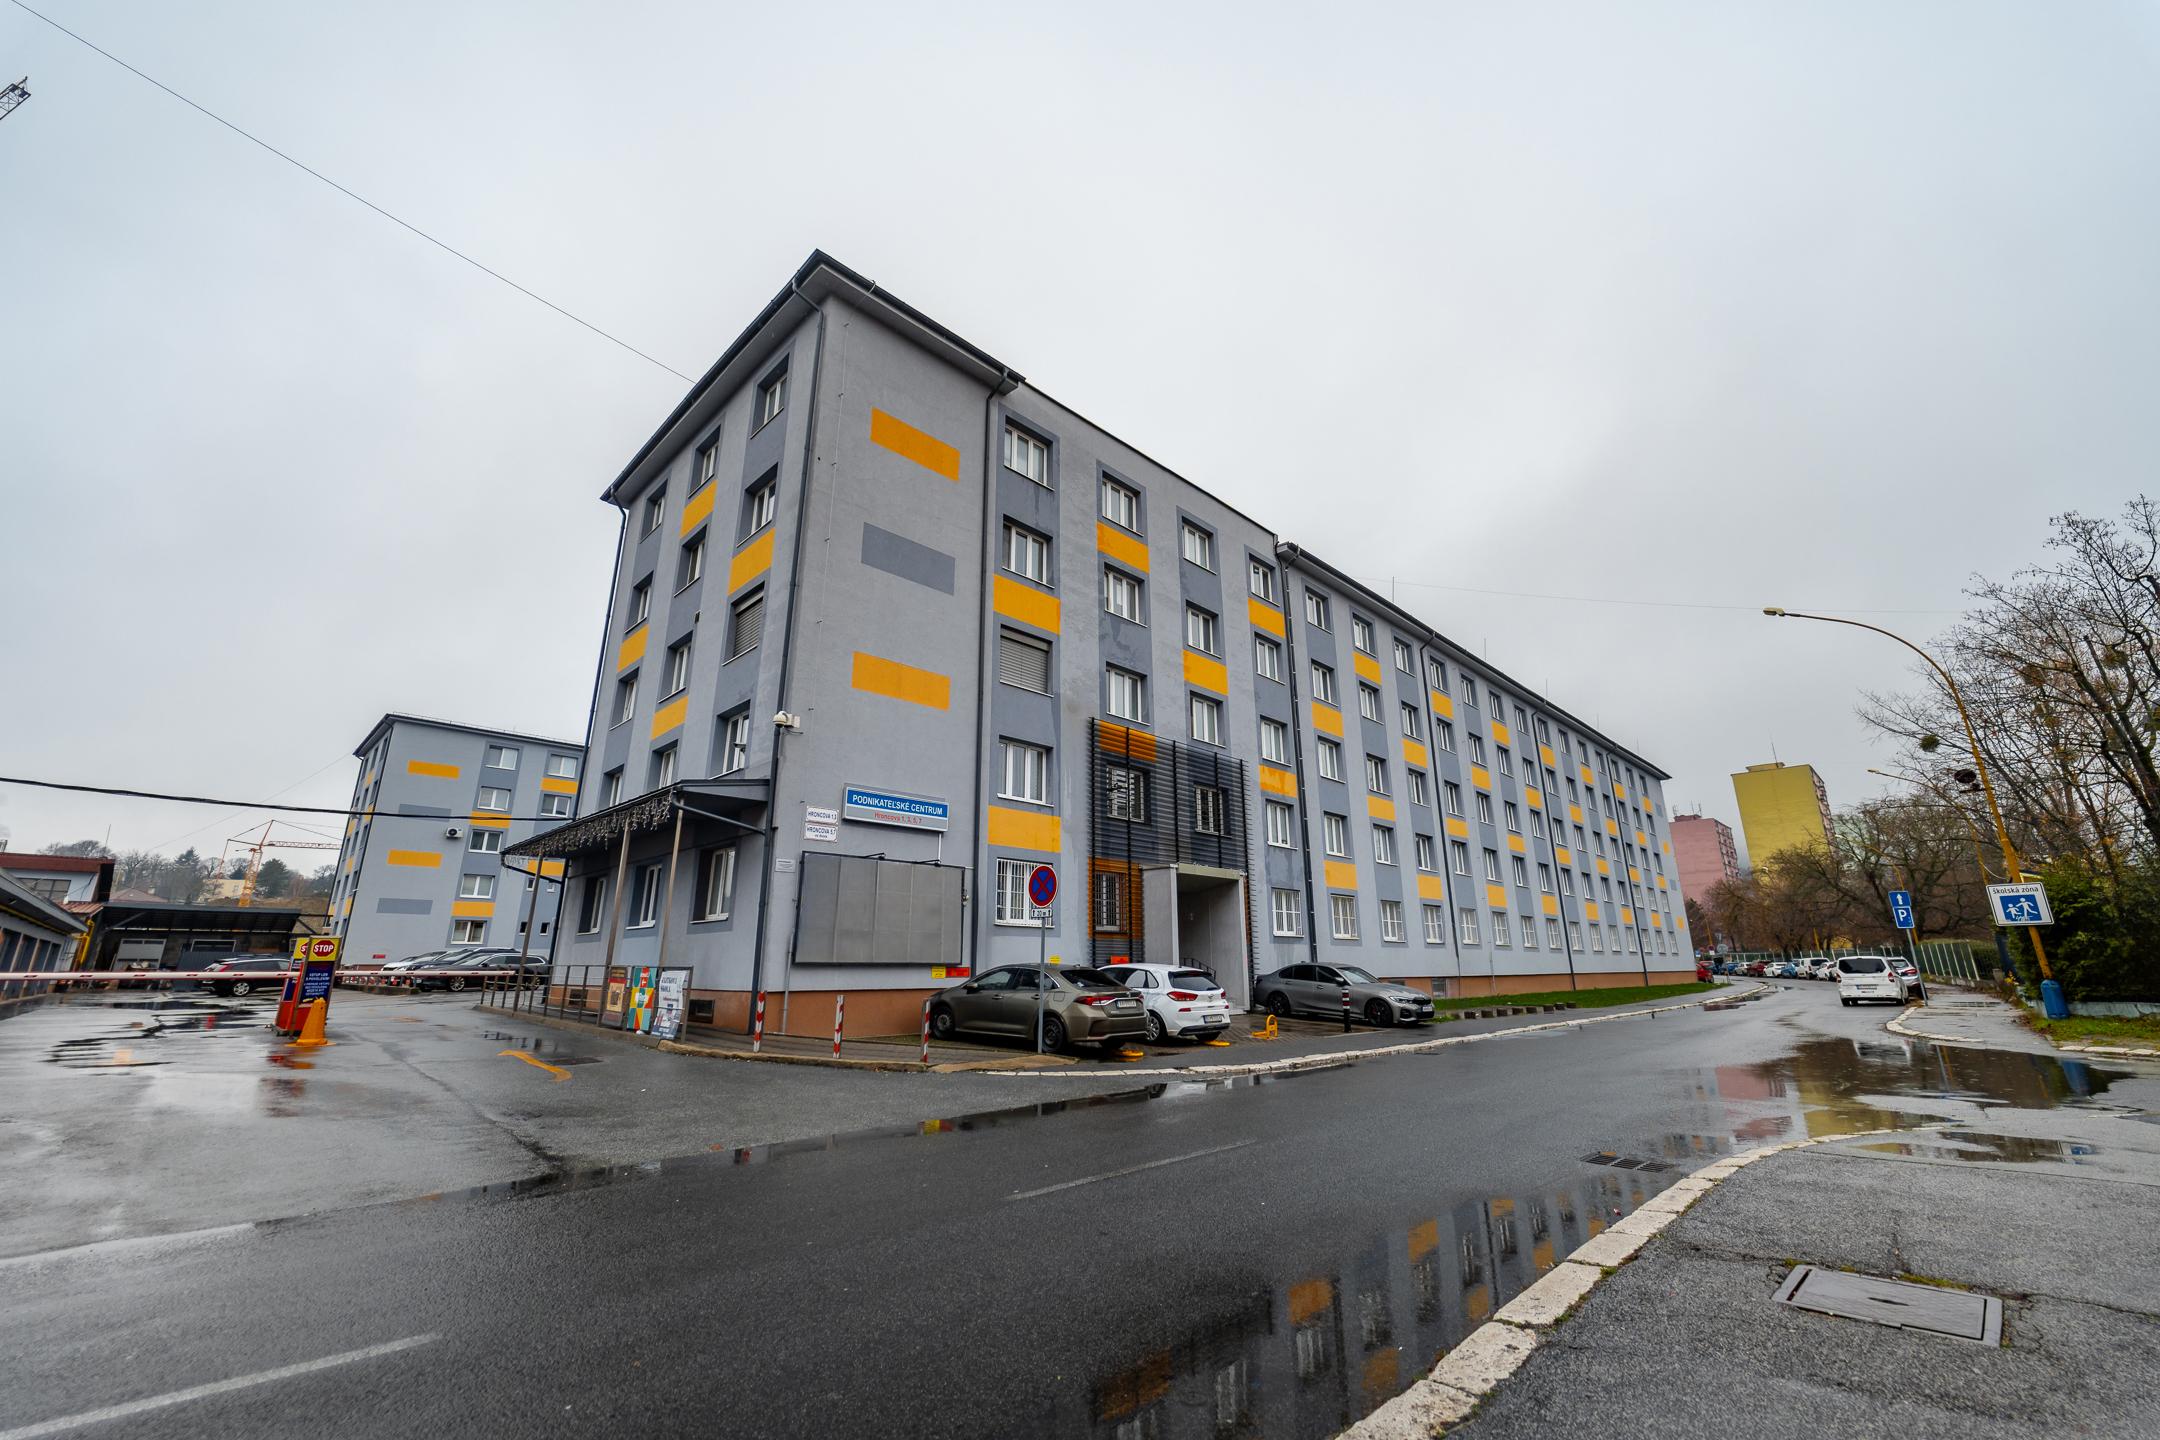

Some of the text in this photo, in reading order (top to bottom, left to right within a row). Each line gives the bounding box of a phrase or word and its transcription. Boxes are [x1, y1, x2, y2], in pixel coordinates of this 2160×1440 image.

[852, 794, 943, 815] PODNIKATEĽSKÉ CENTRUM
[808, 811, 831, 819] HRONCOVA
[807, 826, 830, 834] HRONCOVA
[1992, 887, 2020, 895] školská
[1898, 909, 1907, 922] P
[314, 944, 334, 953] STOP
